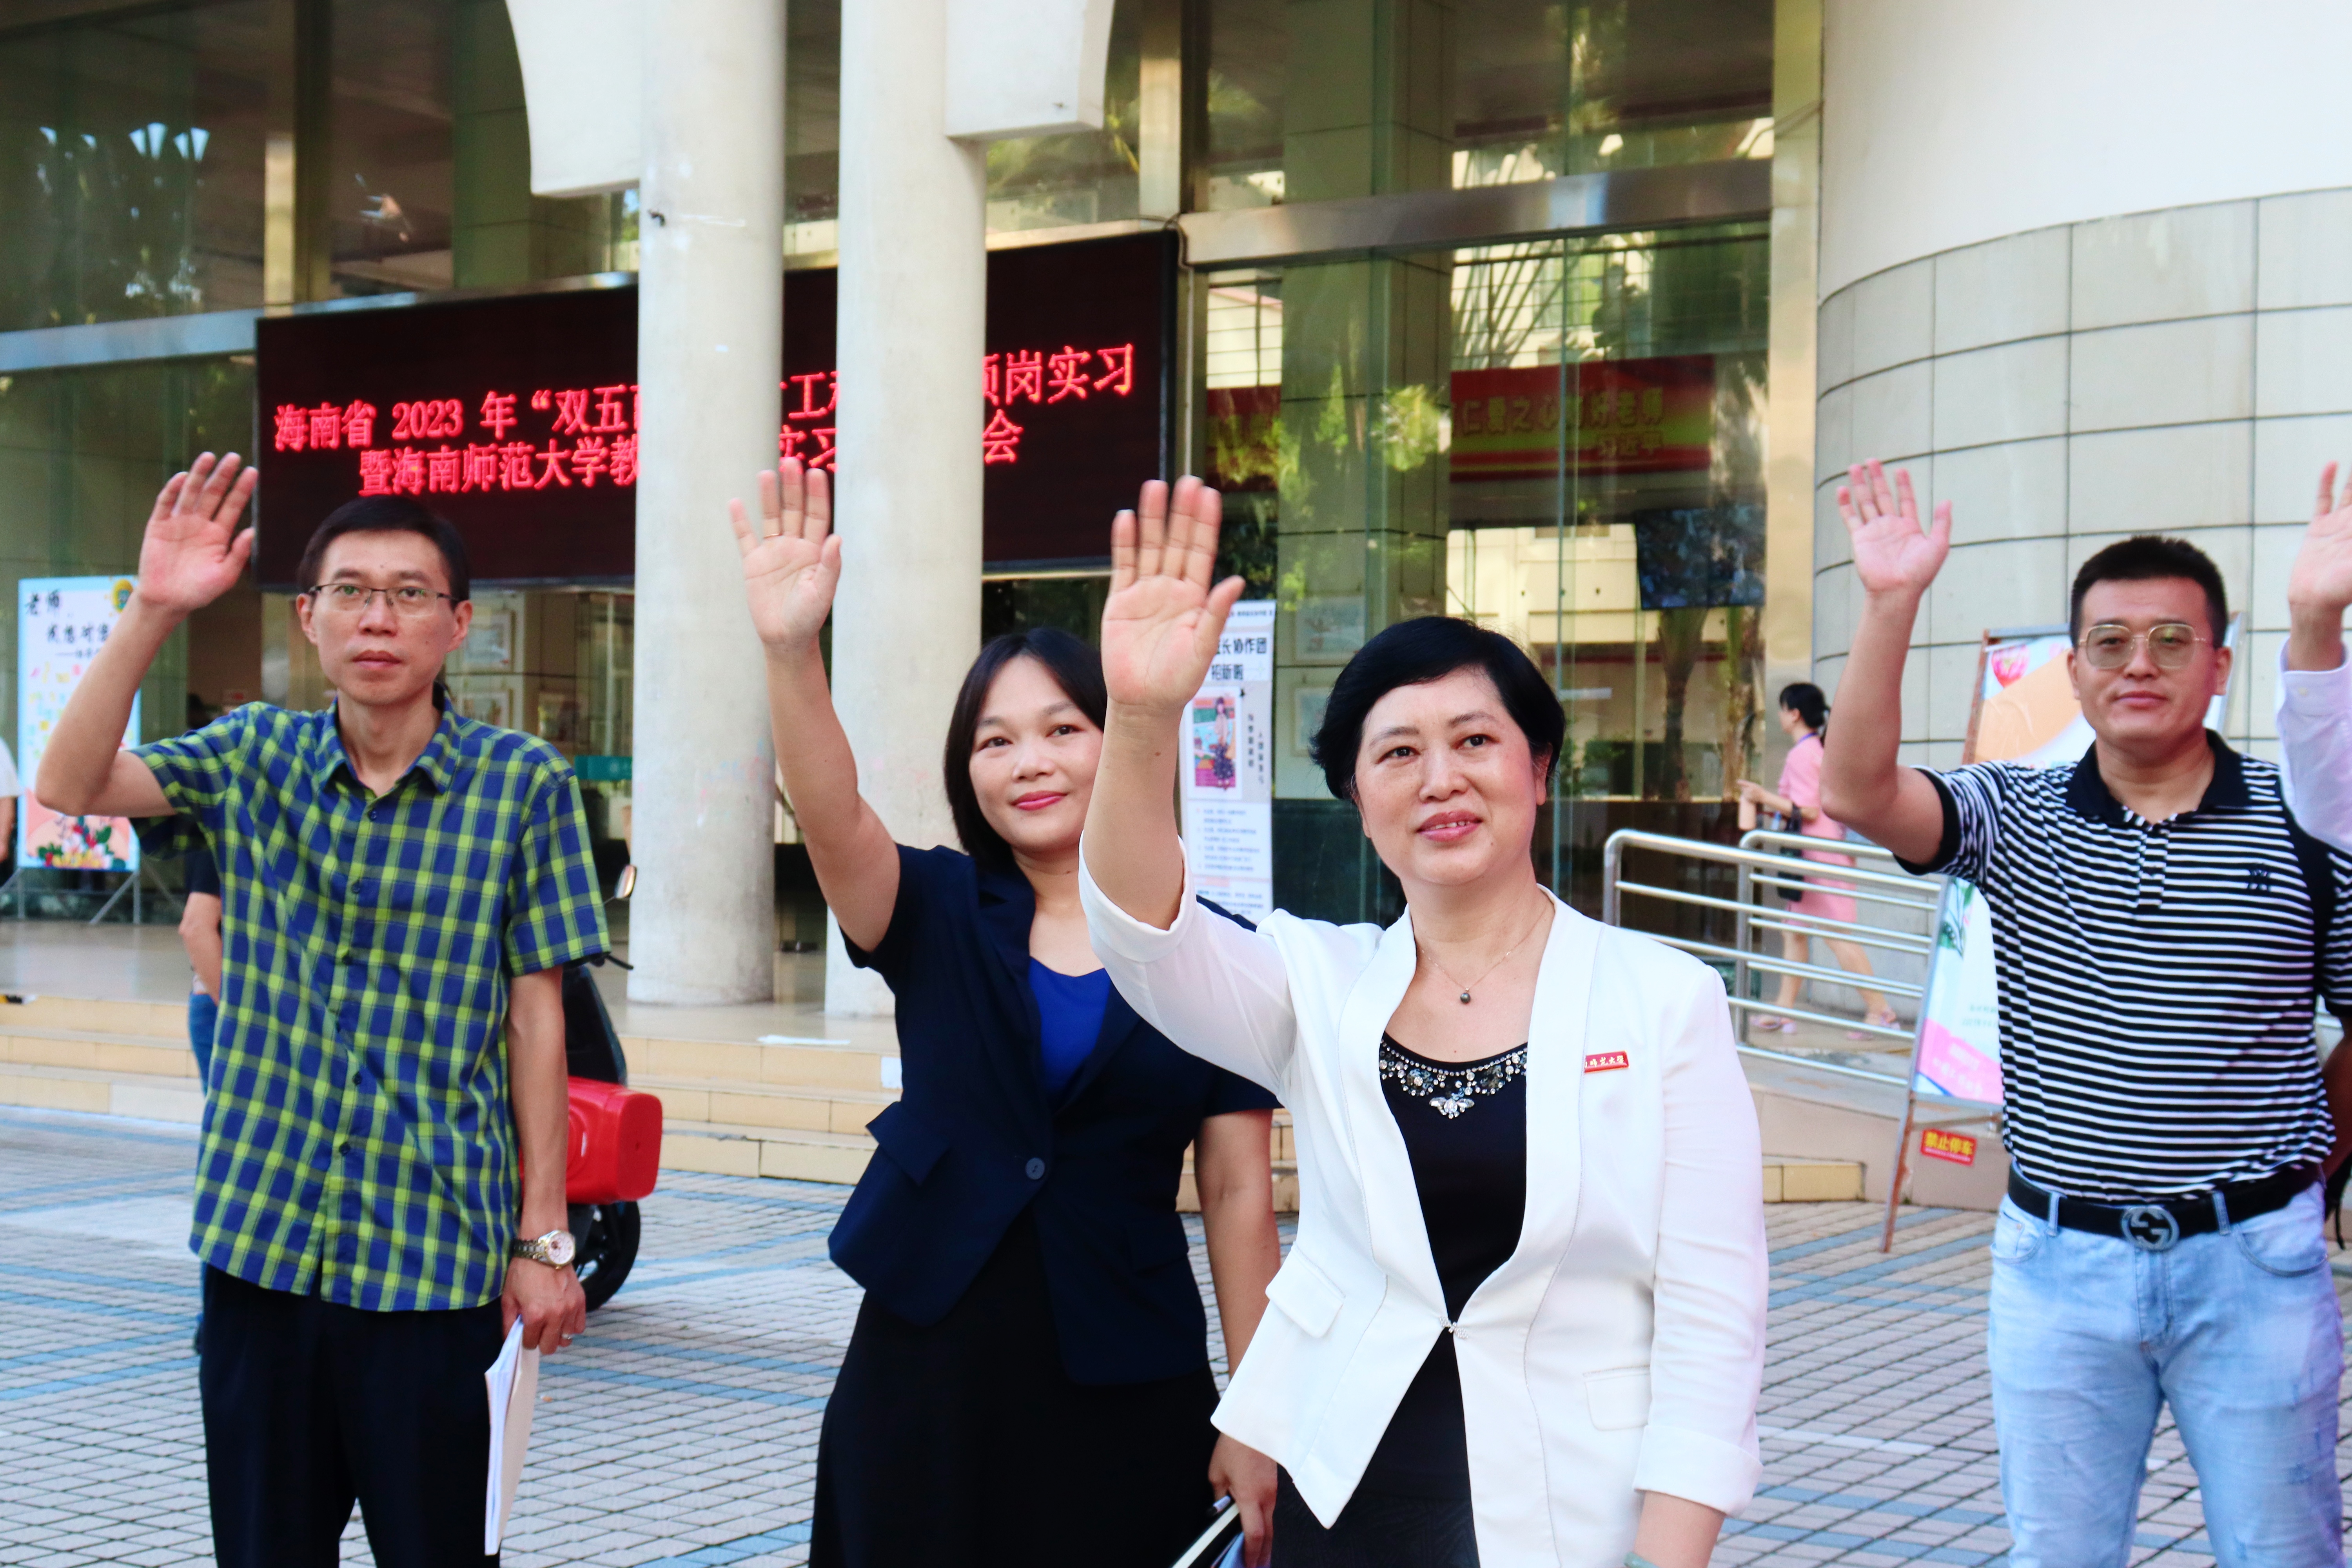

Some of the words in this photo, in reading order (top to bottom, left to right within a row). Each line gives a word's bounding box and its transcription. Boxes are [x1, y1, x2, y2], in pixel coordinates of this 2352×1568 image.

[275, 400, 377, 451] 海南省
[392, 399, 463, 439] 2023
[982, 409, 1024, 463] 会
[1217, 637, 1267, 654] 长协作团
[1585, 1055, 1624, 1067] 师范大学
[1926, 1132, 1974, 1155] 禁止停车
